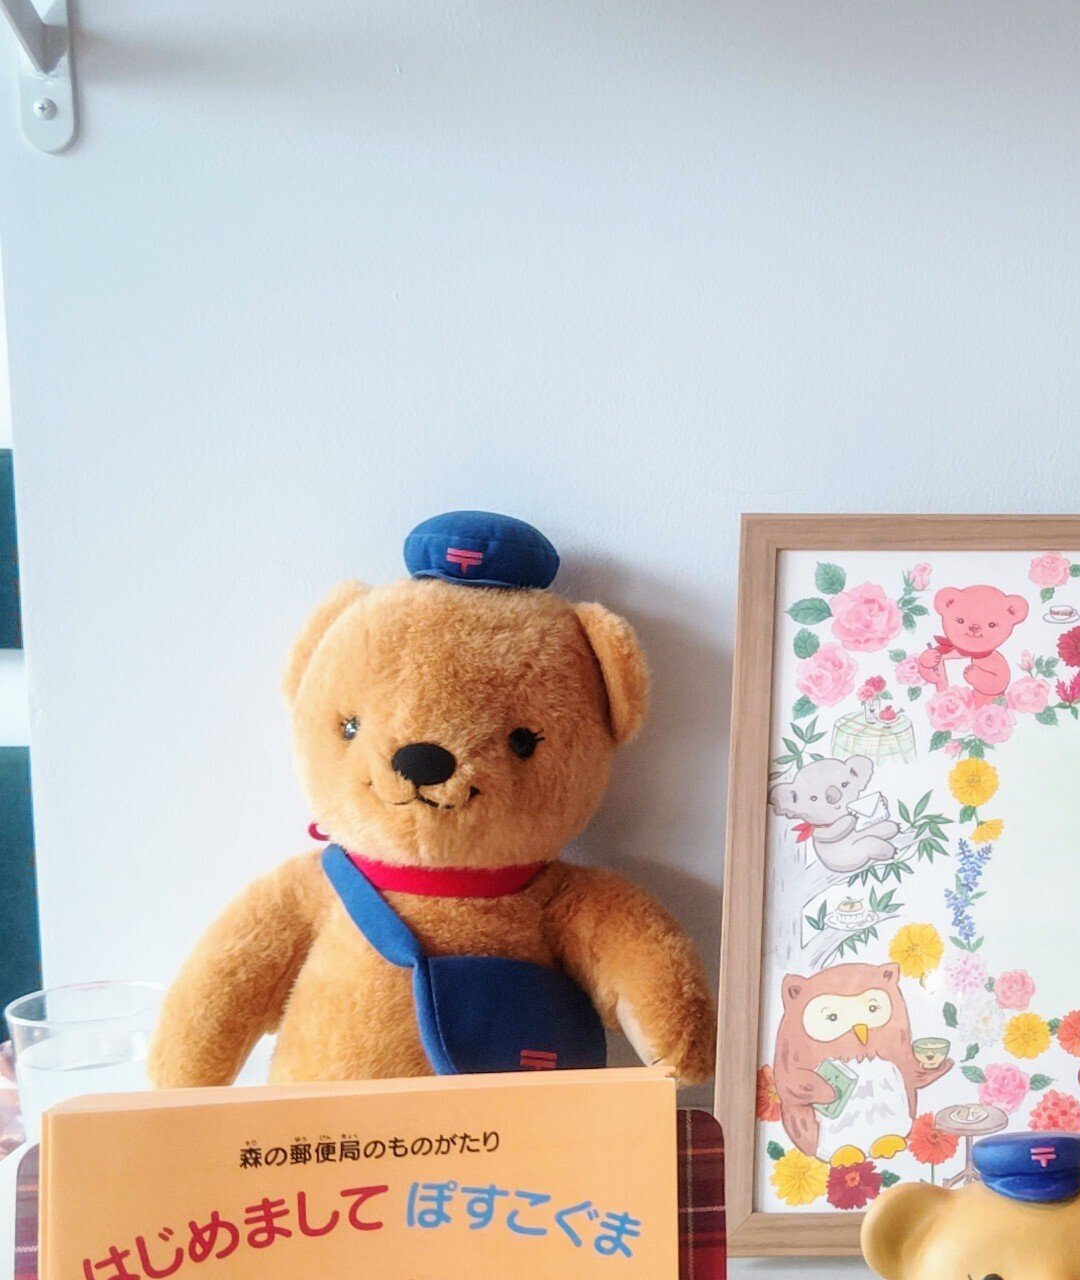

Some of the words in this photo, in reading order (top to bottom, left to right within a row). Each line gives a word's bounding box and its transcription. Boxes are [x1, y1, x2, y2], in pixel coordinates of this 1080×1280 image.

[239, 1131, 499, 1169] 森の郵便局のものがたり
[406, 1181, 641, 1258] ぽすこぐま
